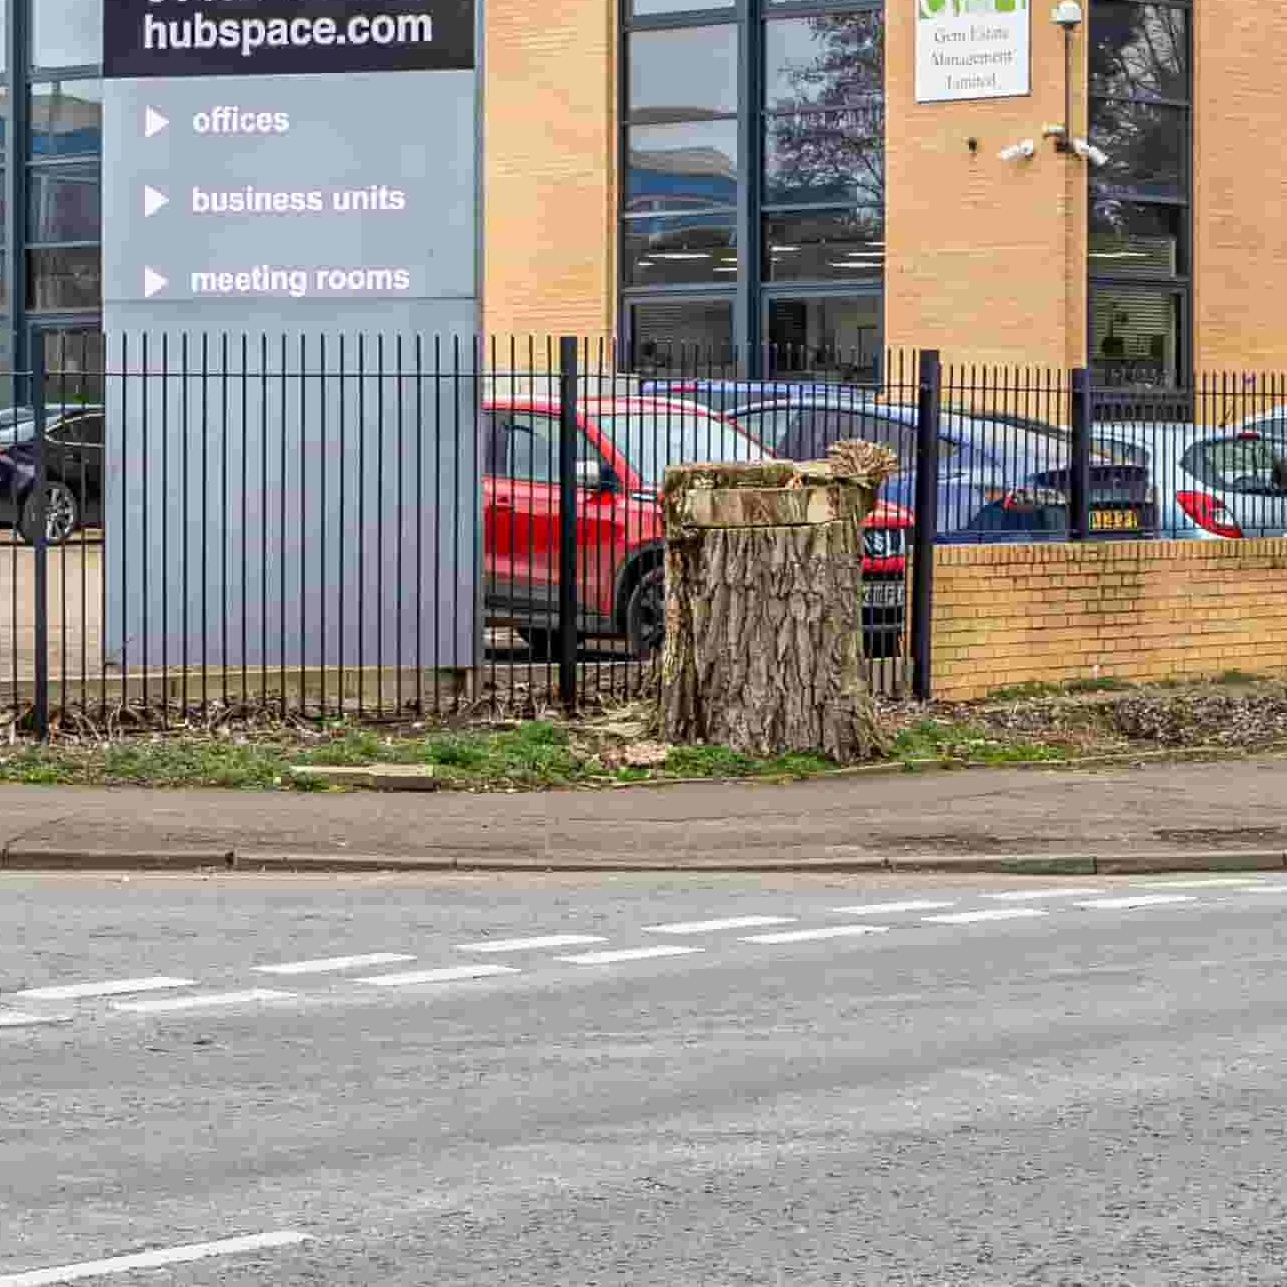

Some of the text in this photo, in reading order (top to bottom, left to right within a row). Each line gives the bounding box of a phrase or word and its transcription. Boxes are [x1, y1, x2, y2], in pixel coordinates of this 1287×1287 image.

[144, 12, 433, 56] hubspace.com
[192, 106, 290, 133] offices
[192, 185, 406, 213] business units
[191, 265, 410, 297] meeting rooms
